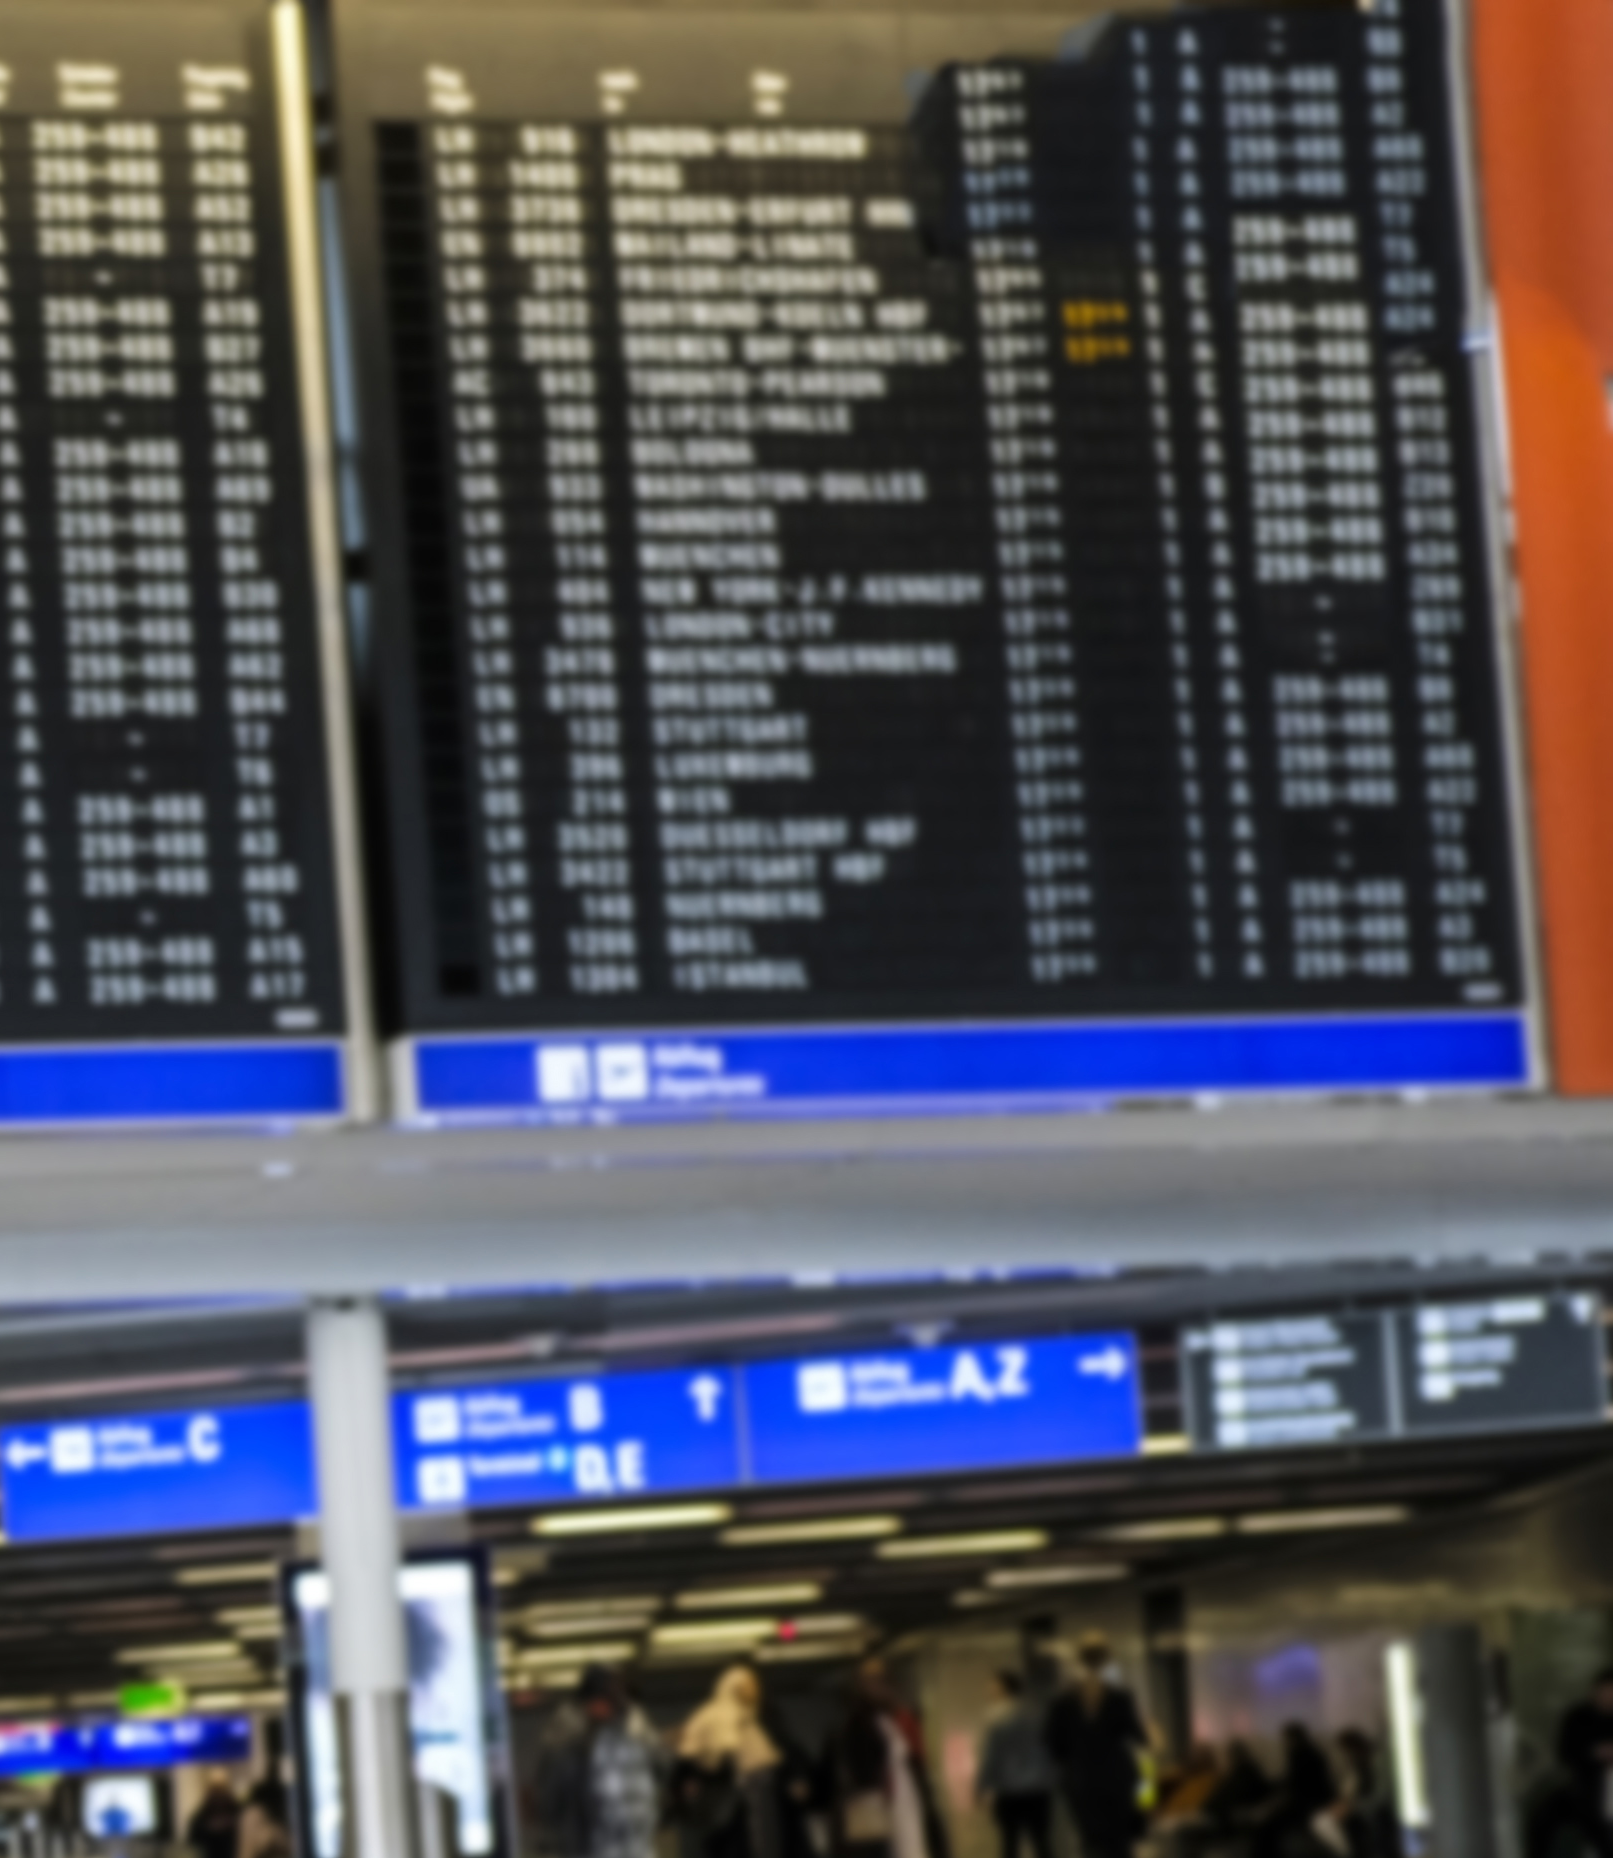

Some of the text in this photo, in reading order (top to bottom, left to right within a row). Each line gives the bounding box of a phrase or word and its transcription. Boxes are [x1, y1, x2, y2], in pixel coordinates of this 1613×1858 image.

[653, 716, 805, 744] STUTTGART
[667, 926, 751, 955] BASEL
[570, 1385, 602, 1431] B
[187, 1415, 220, 1462] C
